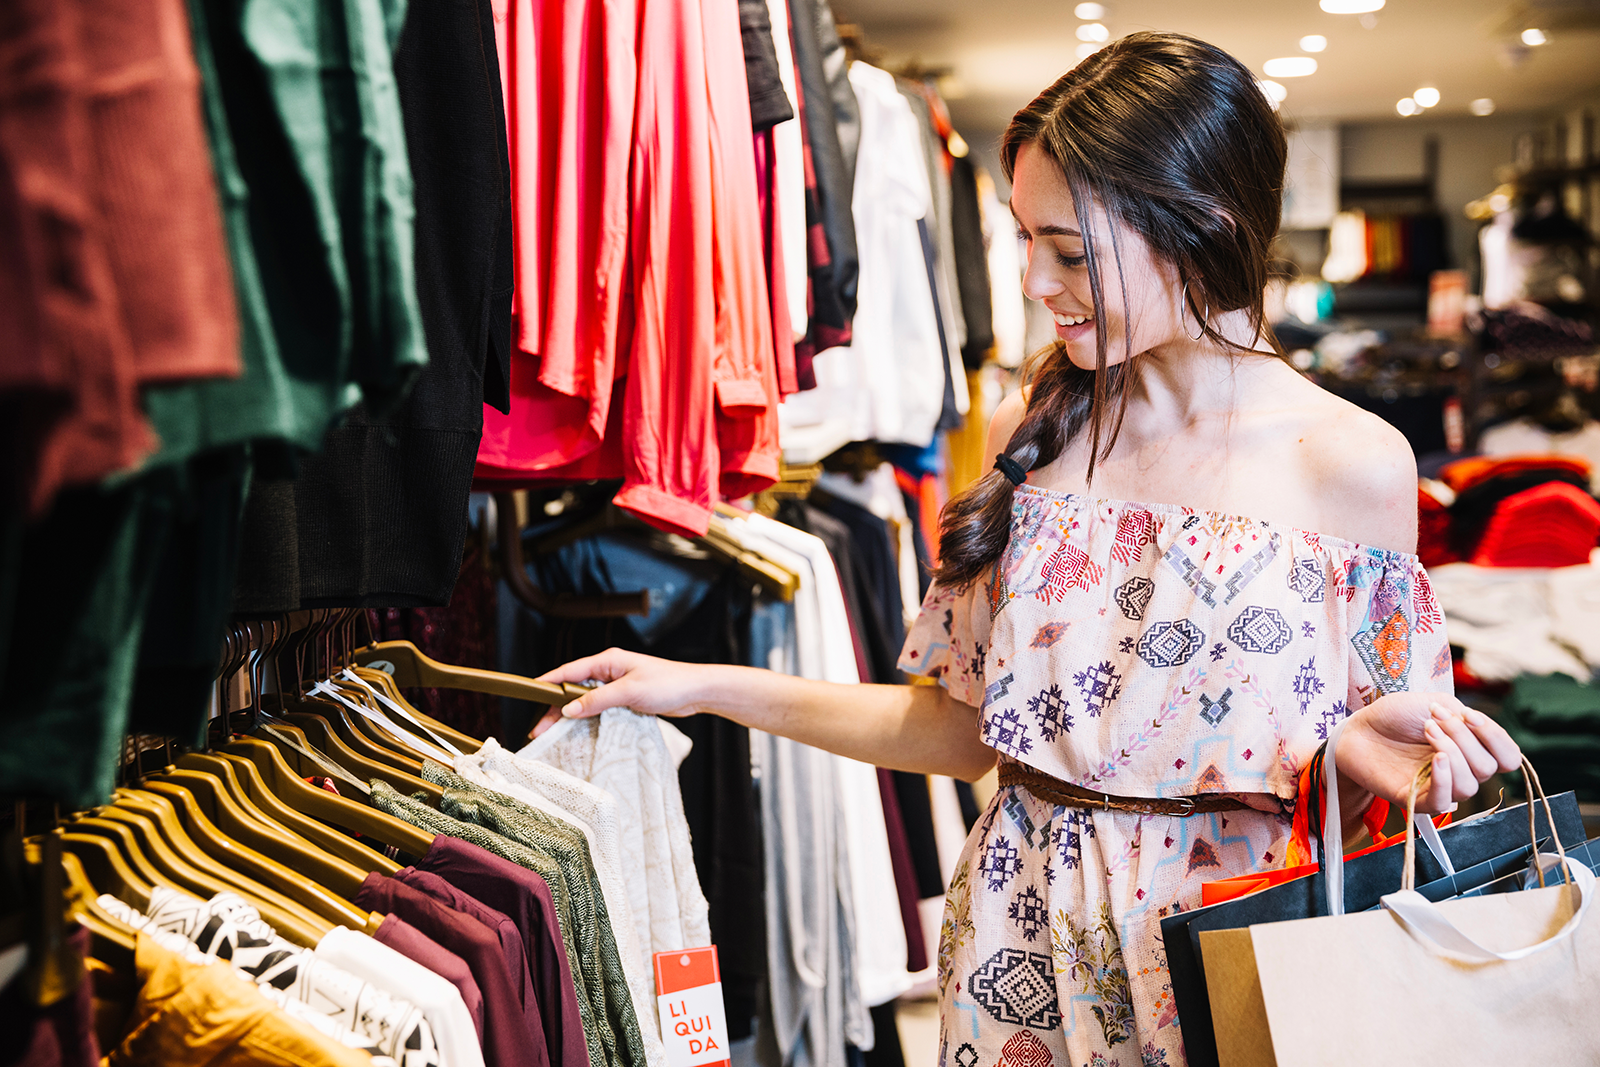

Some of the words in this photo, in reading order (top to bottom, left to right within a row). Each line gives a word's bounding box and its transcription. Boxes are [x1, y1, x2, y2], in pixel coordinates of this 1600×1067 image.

[669, 1000, 687, 1018] LI
[674, 1015, 711, 1036] QUI
[688, 1036, 719, 1055] DA
